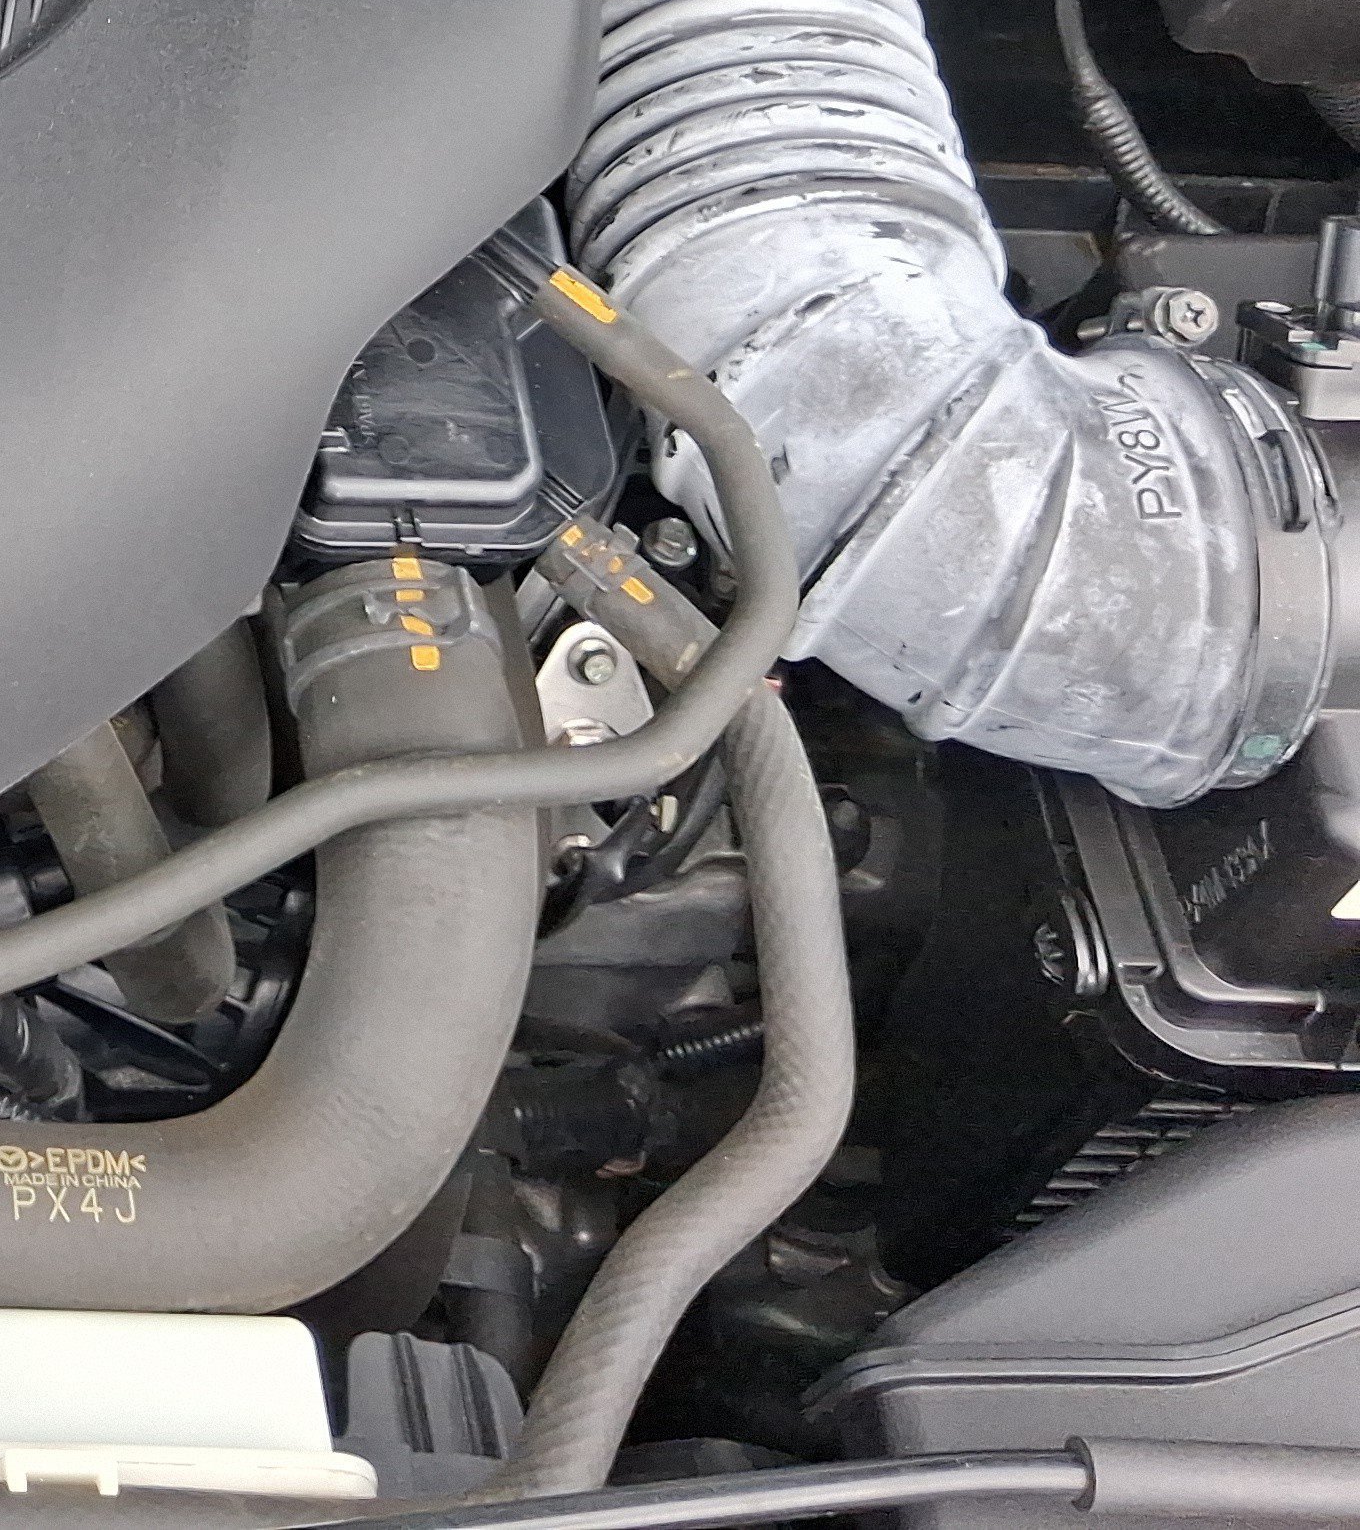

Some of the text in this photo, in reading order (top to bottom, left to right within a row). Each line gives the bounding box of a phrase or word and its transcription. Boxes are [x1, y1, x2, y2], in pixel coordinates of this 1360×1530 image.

[3, 1172, 142, 1190] MADE IN CHINA
